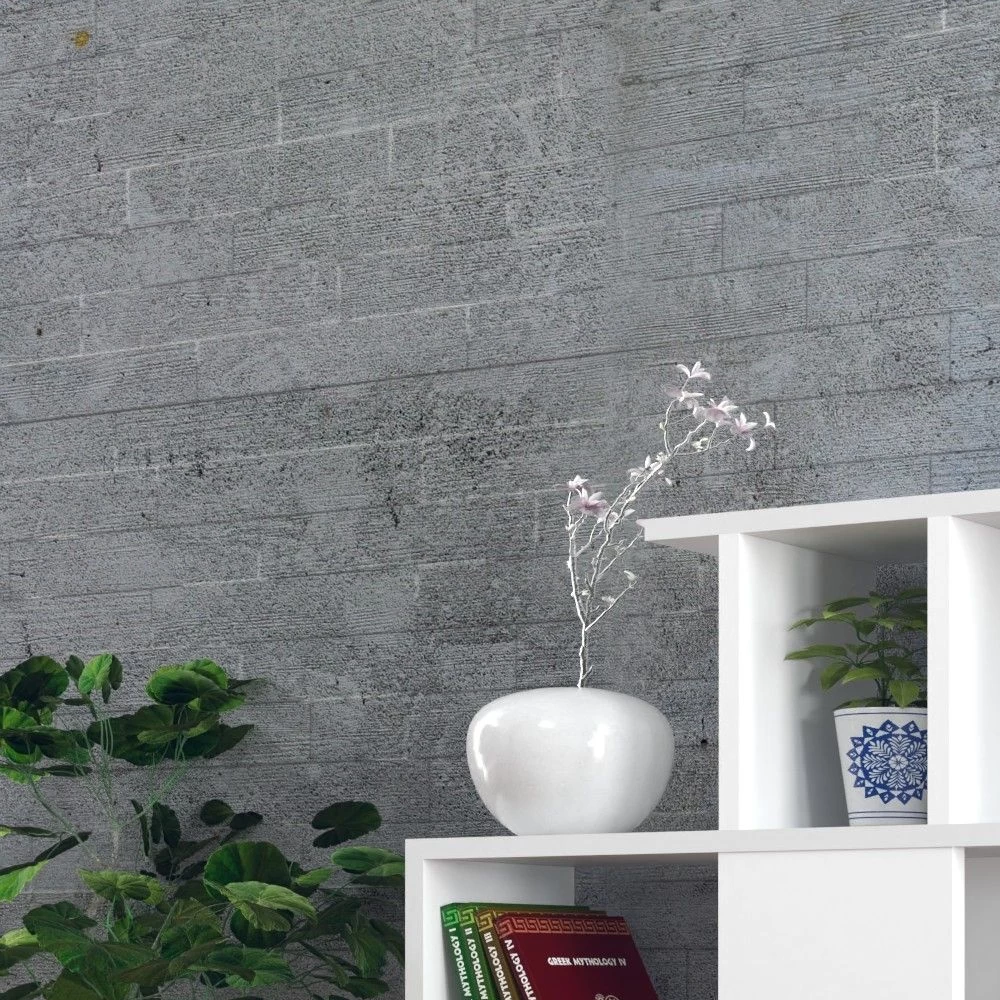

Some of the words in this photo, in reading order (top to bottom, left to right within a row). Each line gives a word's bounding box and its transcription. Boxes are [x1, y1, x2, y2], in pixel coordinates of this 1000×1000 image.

[484, 932, 493, 943] III
[505, 939, 515, 950] IV
[450, 935, 472, 997] MYTHOLOGY
[547, 957, 572, 966] GREEK
[572, 957, 617, 966] MYTHOLOGY
[618, 958, 627, 966] IV
[467, 938, 488, 1000] MYTHOLOGY
